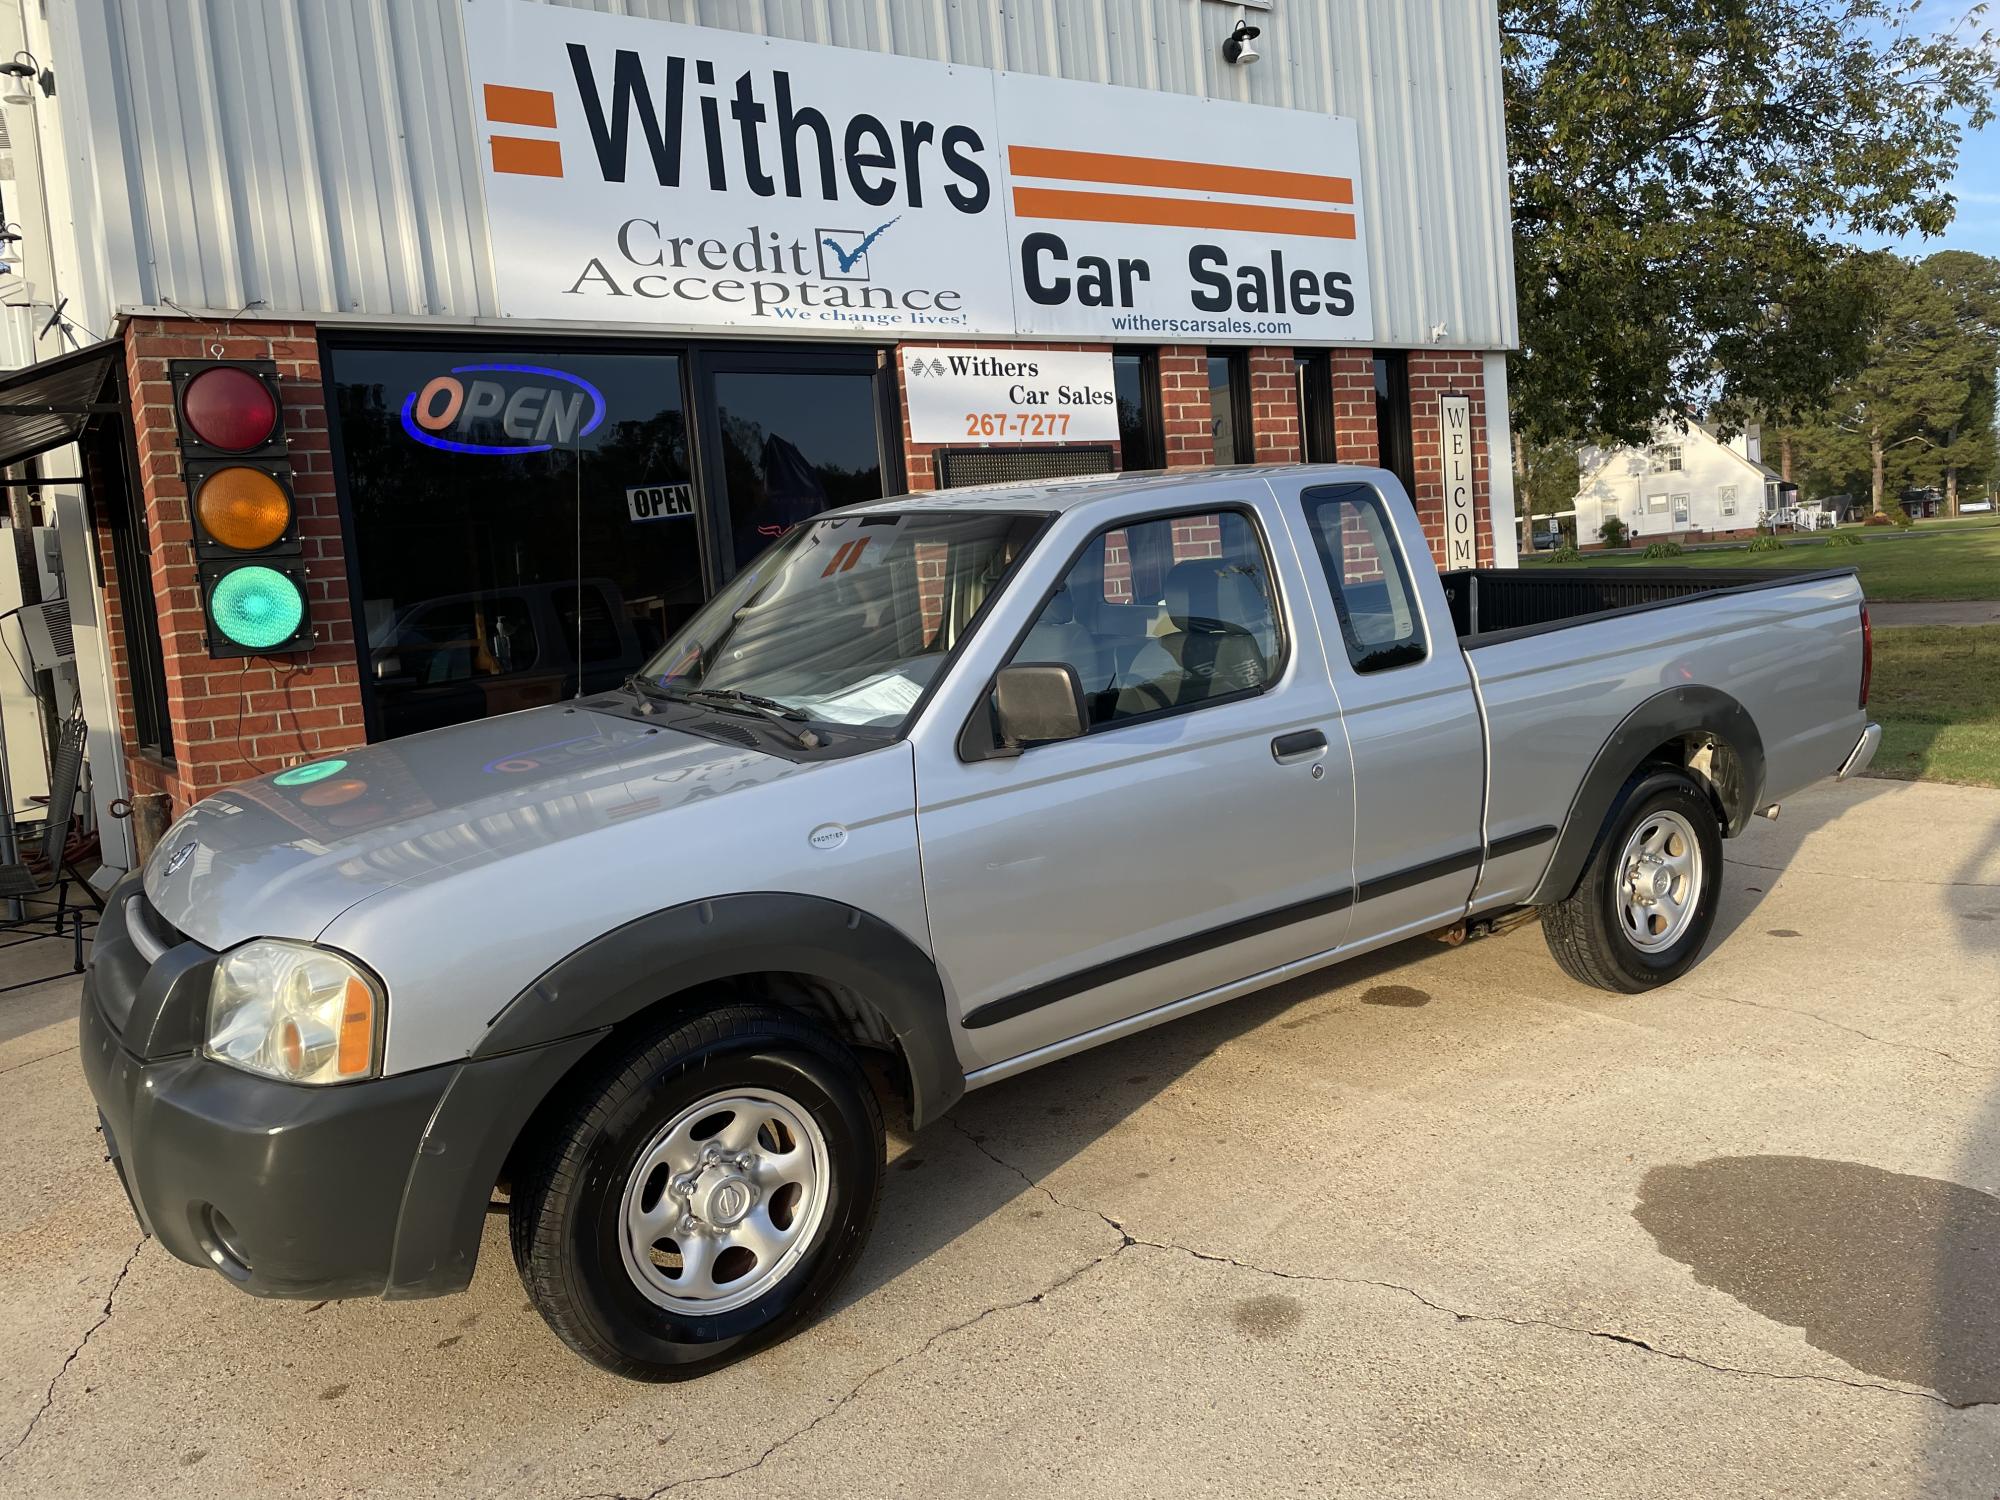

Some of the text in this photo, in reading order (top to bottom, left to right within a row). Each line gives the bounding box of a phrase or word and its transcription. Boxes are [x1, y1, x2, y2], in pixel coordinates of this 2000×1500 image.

[566, 43, 991, 214] Withers
[617, 218, 812, 276] Credit
[562, 257, 962, 316] Acceptance
[1021, 232, 1355, 317] Car Sales
[774, 306, 967, 326] We change lives!
[1112, 314, 1292, 335] witherscarsales.com
[947, 355, 1039, 377] Withers
[416, 376, 585, 444] OPEN
[1009, 384, 1114, 405] Car Sales
[965, 413, 1071, 436] 267-7277
[633, 486, 693, 518] OPEN
[1446, 408, 1471, 570] WELCOM
[812, 831, 844, 843] FRONTIER
